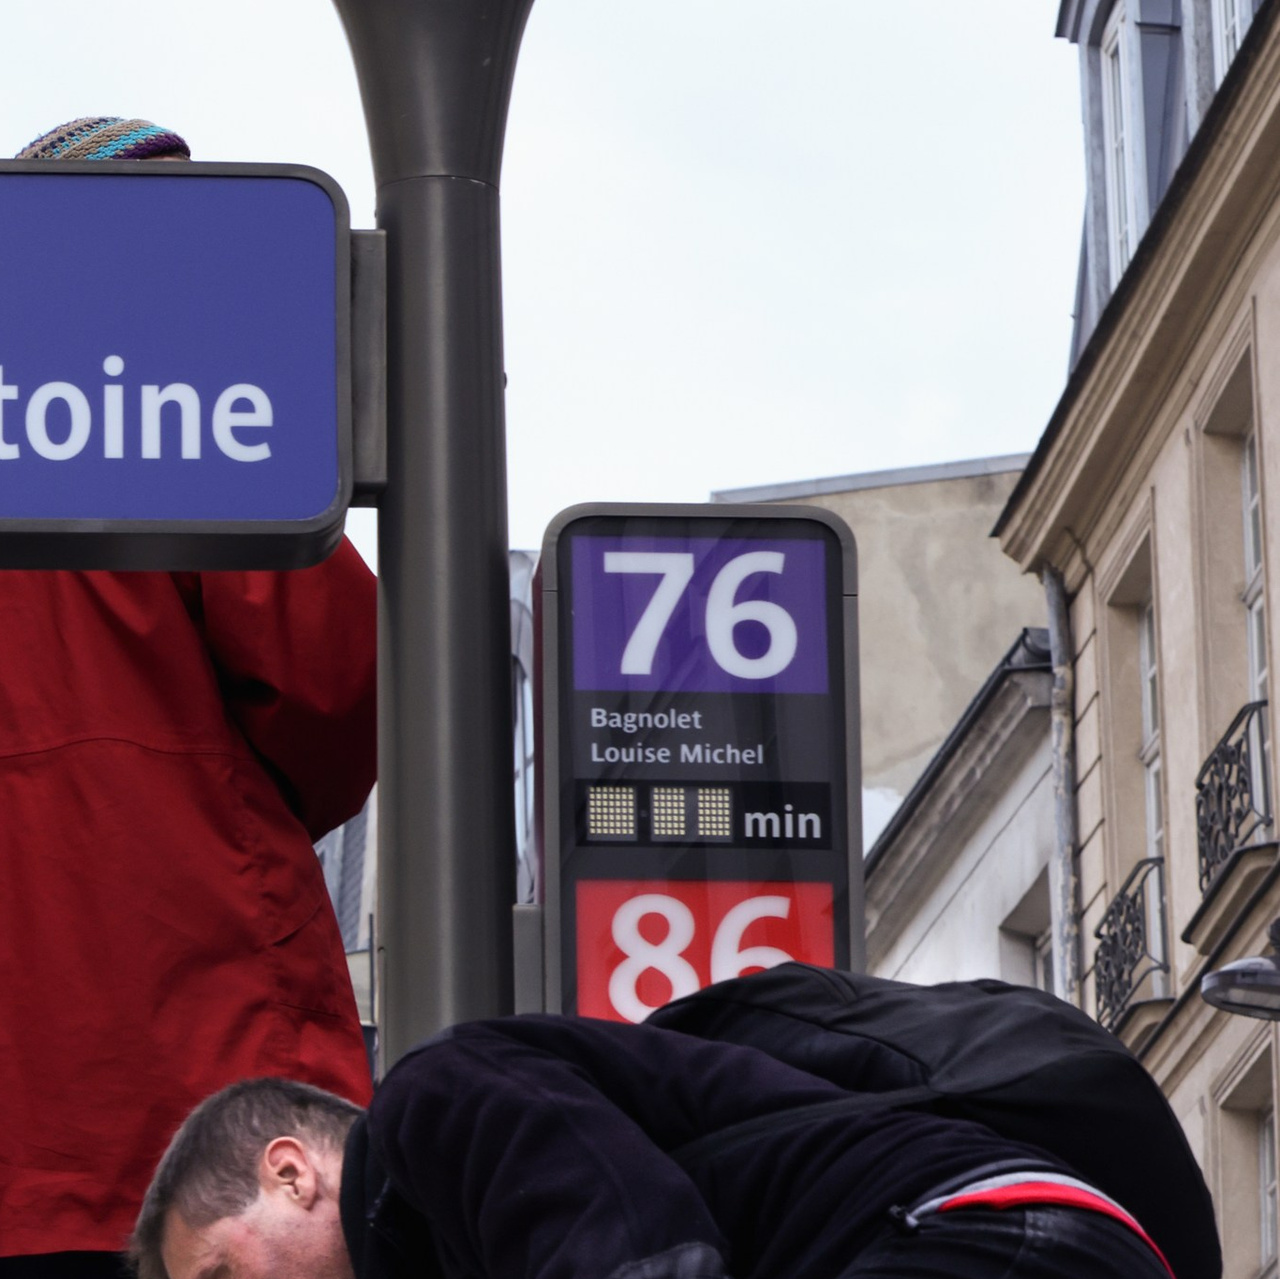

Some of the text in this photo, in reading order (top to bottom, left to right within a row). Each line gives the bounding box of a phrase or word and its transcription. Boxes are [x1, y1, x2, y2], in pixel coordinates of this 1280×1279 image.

[604, 552, 797, 679] 76
[591, 708, 702, 733] Bagnolet
[592, 743, 762, 764] Louise Michel
[745, 804, 820, 838] min
